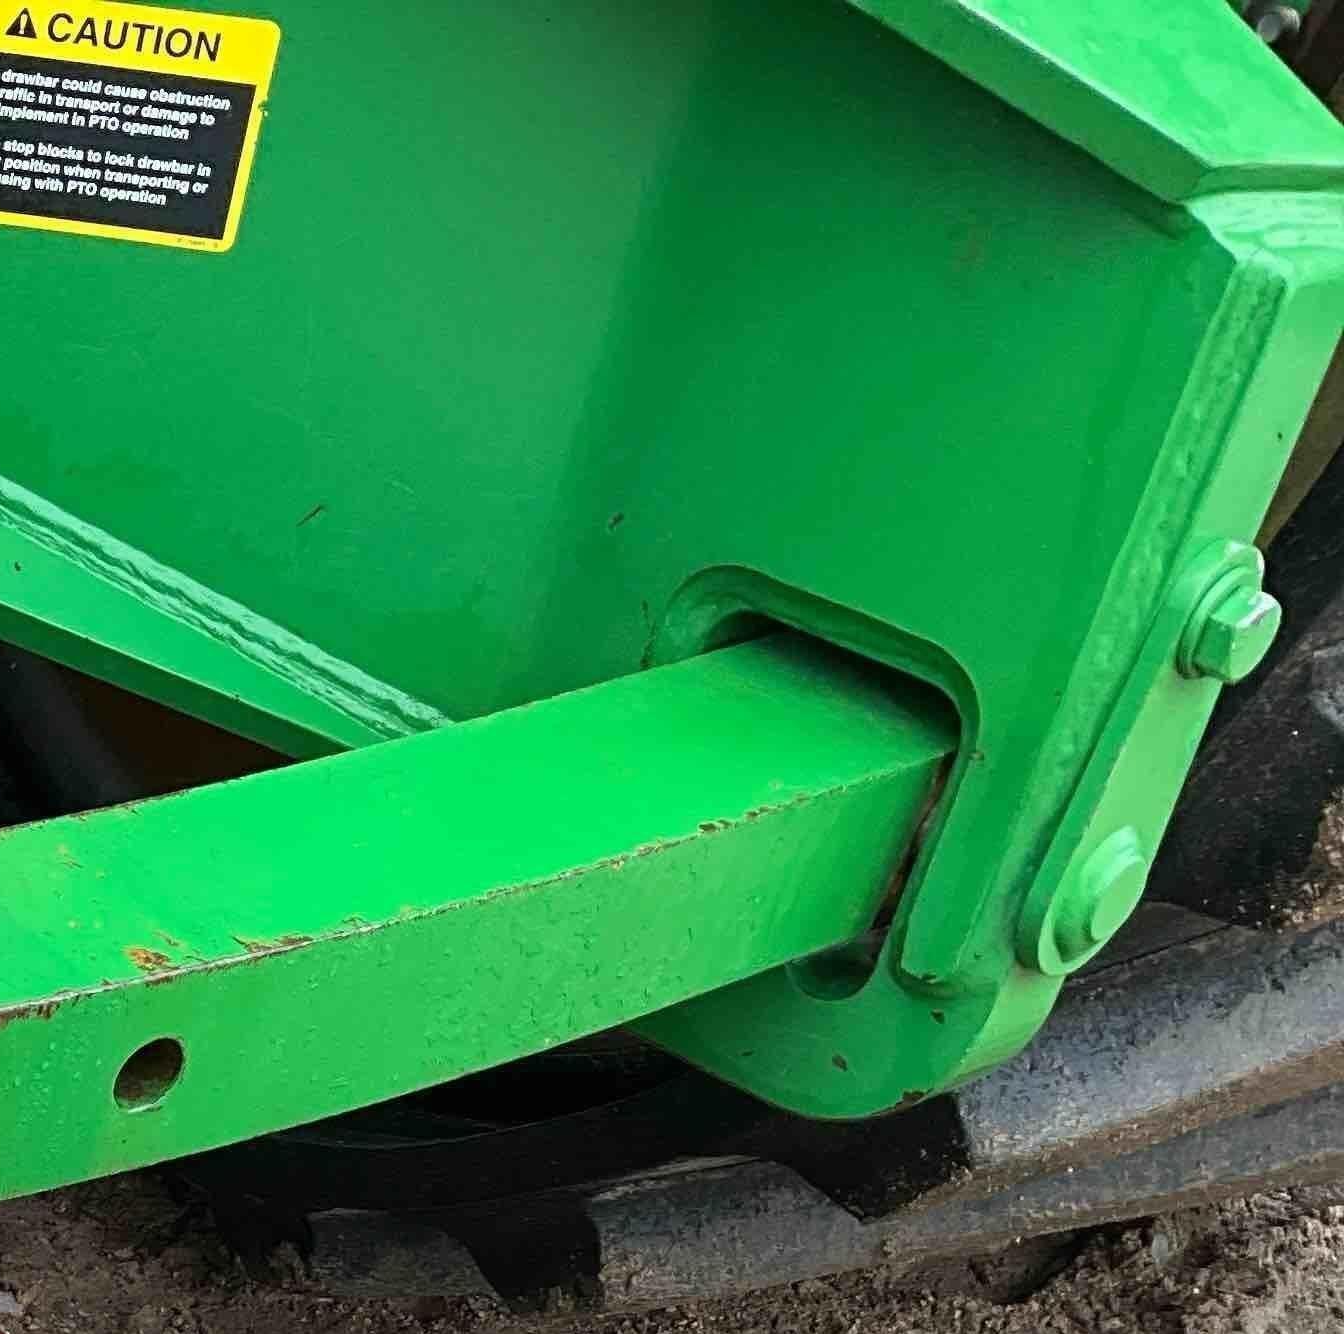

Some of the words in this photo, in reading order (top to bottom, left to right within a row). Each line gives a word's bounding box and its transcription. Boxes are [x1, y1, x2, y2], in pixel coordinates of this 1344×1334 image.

[47, 12, 222, 62] CAUTION
[2, 69, 59, 88] drawbar
[61, 78, 102, 94] could
[104, 84, 147, 99] cause
[150, 89, 230, 110] obstruction
[38, 91, 52, 105] in
[55, 94, 121, 114] transport
[122, 105, 139, 116] or
[141, 105, 198, 125] damage
[200, 112, 215, 126] to
[71, 112, 85, 126] in
[88, 115, 119, 131] PTO
[122, 121, 190, 140] operation
[3, 140, 34, 155] stop
[38, 142, 84, 160] blocks
[87, 149, 102, 162] to
[104, 151, 134, 168] lock
[138, 156, 195, 175] drawbar
[197, 163, 212, 177] in
[3, 157, 61, 174] position
[64, 165, 102, 180] when
[104, 169, 189, 195] transporting
[192, 182, 208, 194] or
[34, 177, 64, 192] with
[67, 180, 98, 195] PTO
[100, 187, 167, 206] operation
